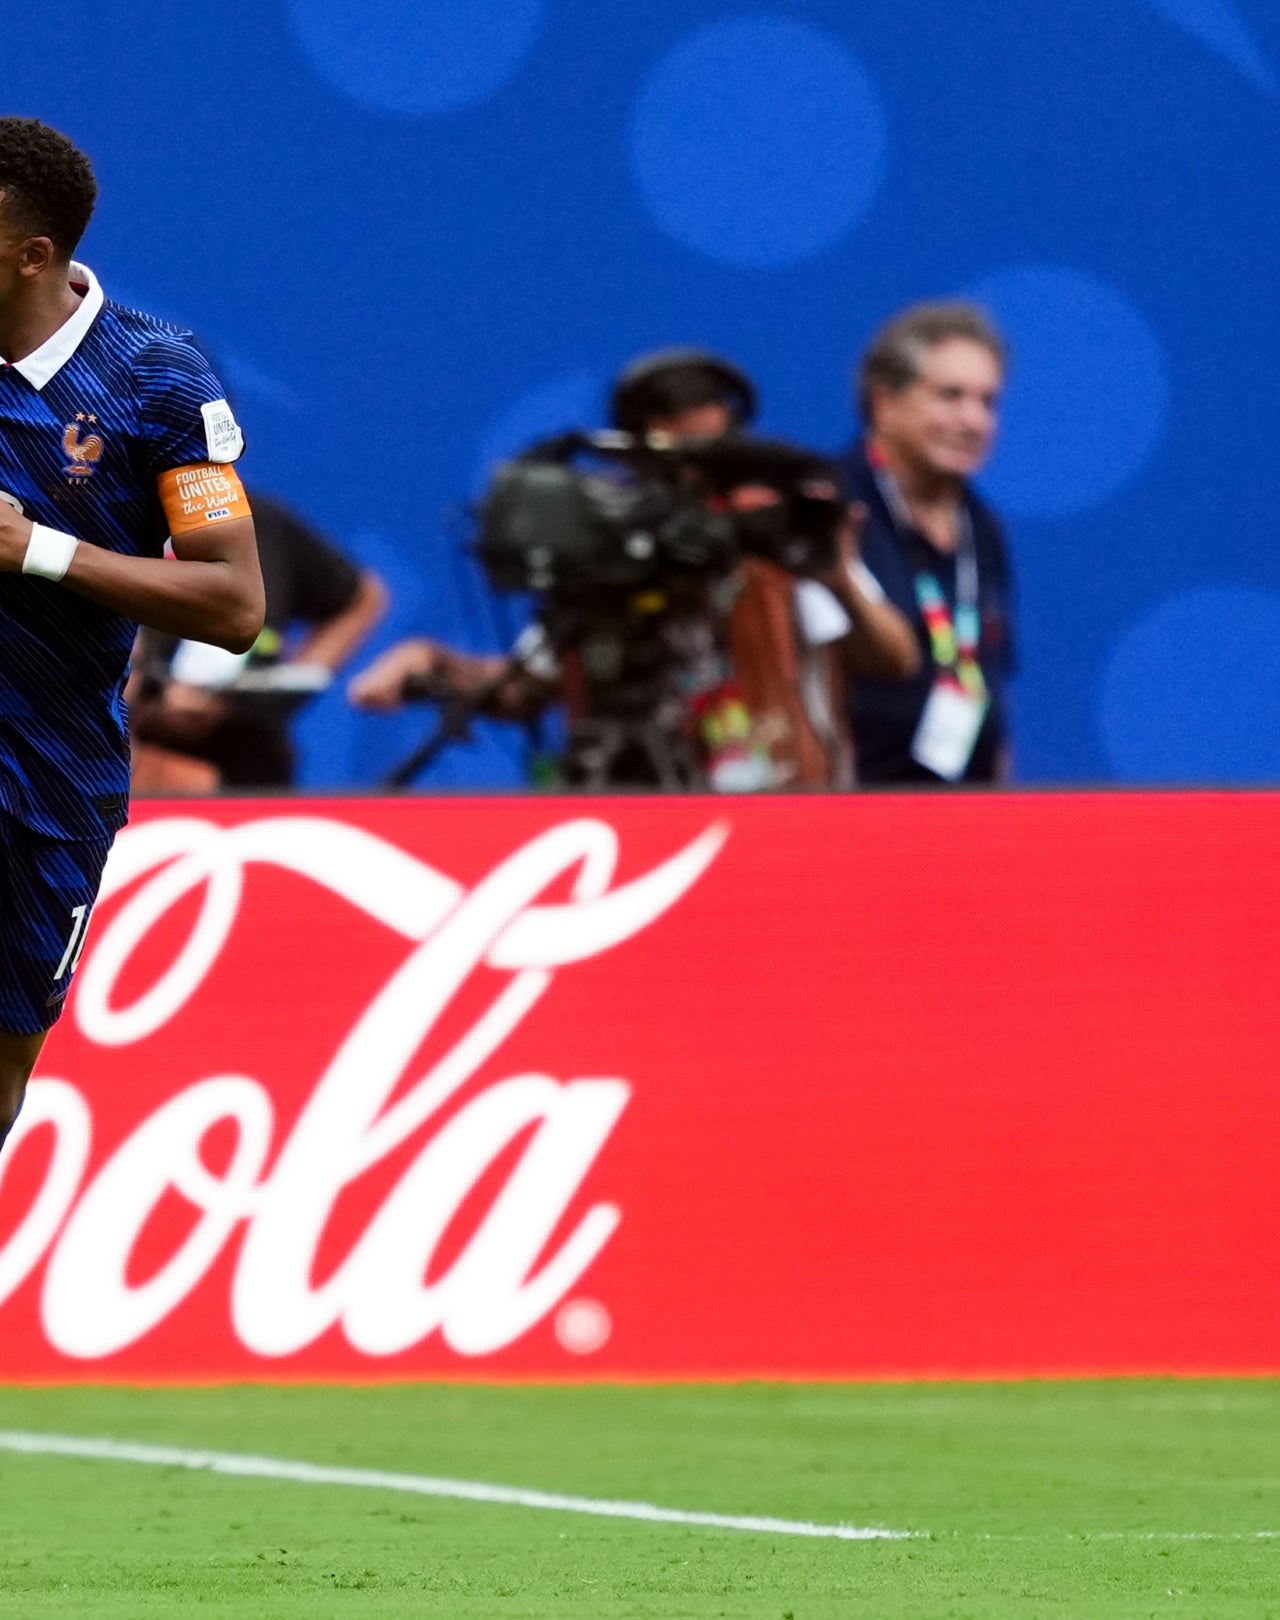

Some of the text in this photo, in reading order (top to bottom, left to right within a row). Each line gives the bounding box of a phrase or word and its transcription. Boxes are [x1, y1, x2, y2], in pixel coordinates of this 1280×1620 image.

[175, 465, 224, 486] FOOTBALL
[178, 476, 231, 501] UNITES
[182, 489, 239, 515] the World
[207, 508, 229, 519] FIFA
